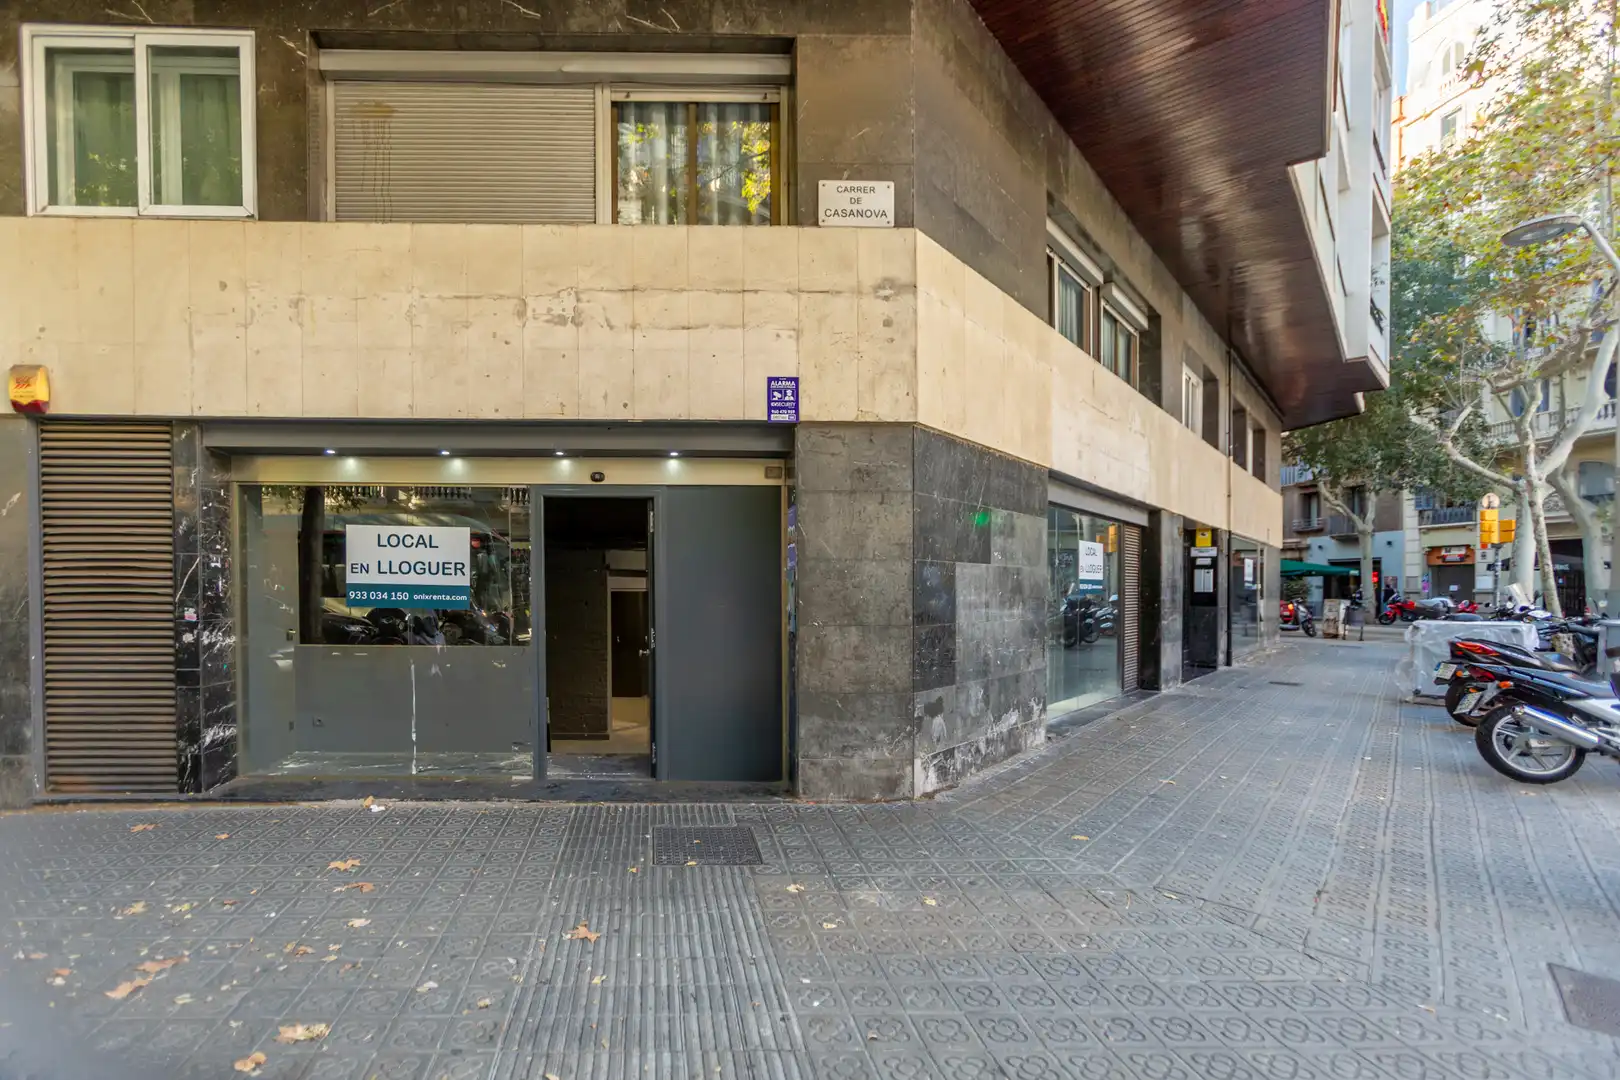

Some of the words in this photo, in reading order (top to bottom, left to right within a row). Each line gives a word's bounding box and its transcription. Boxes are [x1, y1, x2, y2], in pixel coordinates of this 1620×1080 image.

[837, 185, 876, 194] CARRER
[849, 197, 862, 205] DE
[824, 208, 888, 219] CASANOVA
[377, 533, 439, 549] LOCAL
[350, 562, 370, 575] EN
[377, 560, 466, 577] LLOGUER
[349, 590, 368, 600] 933
[369, 591, 388, 601] 034
[390, 592, 409, 601] 150
[413, 593, 468, 601] onixrenta.com
